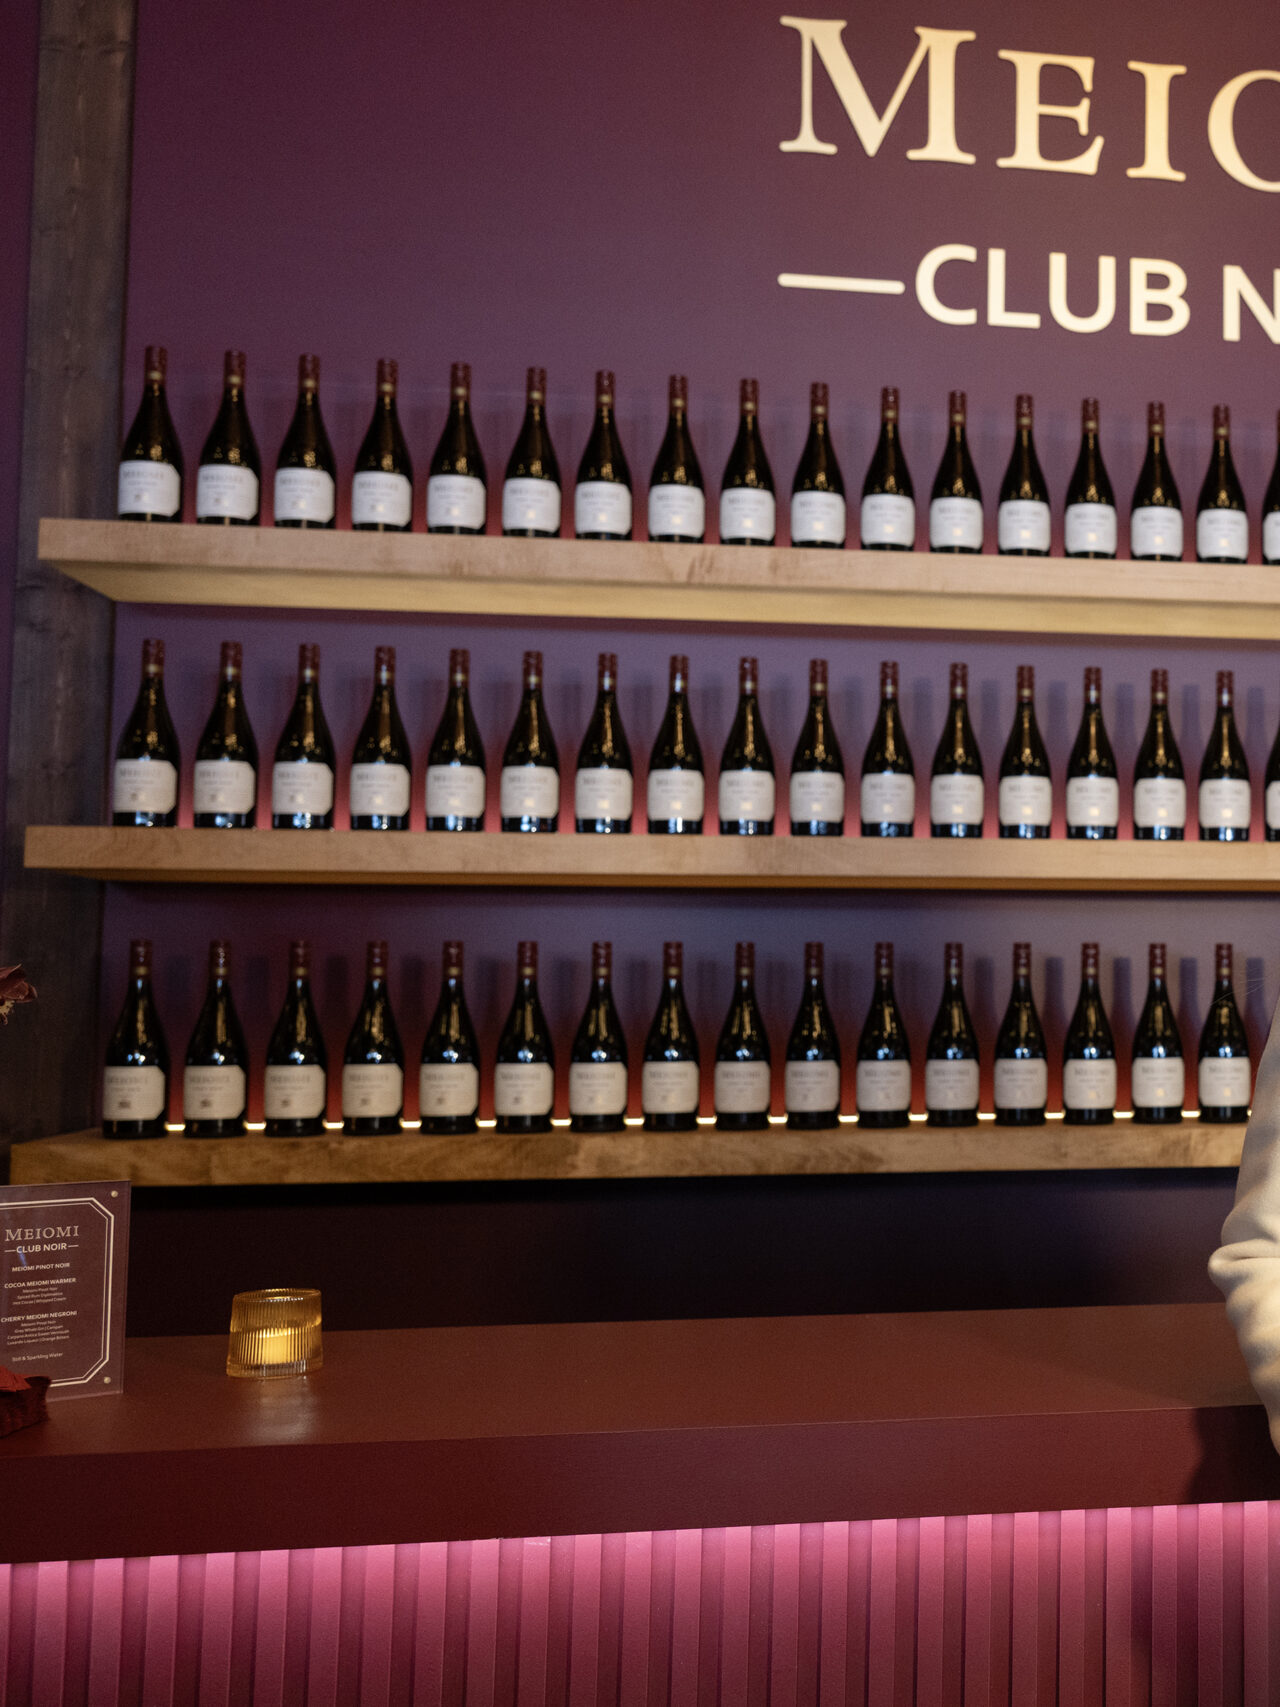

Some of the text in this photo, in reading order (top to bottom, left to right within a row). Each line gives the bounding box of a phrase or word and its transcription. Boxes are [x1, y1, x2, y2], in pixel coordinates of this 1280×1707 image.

[915, 243, 1191, 338] CLUB
[5, 1226, 79, 1241] MEIOMI
[16, 1242, 67, 1254] CLUB NOIR
